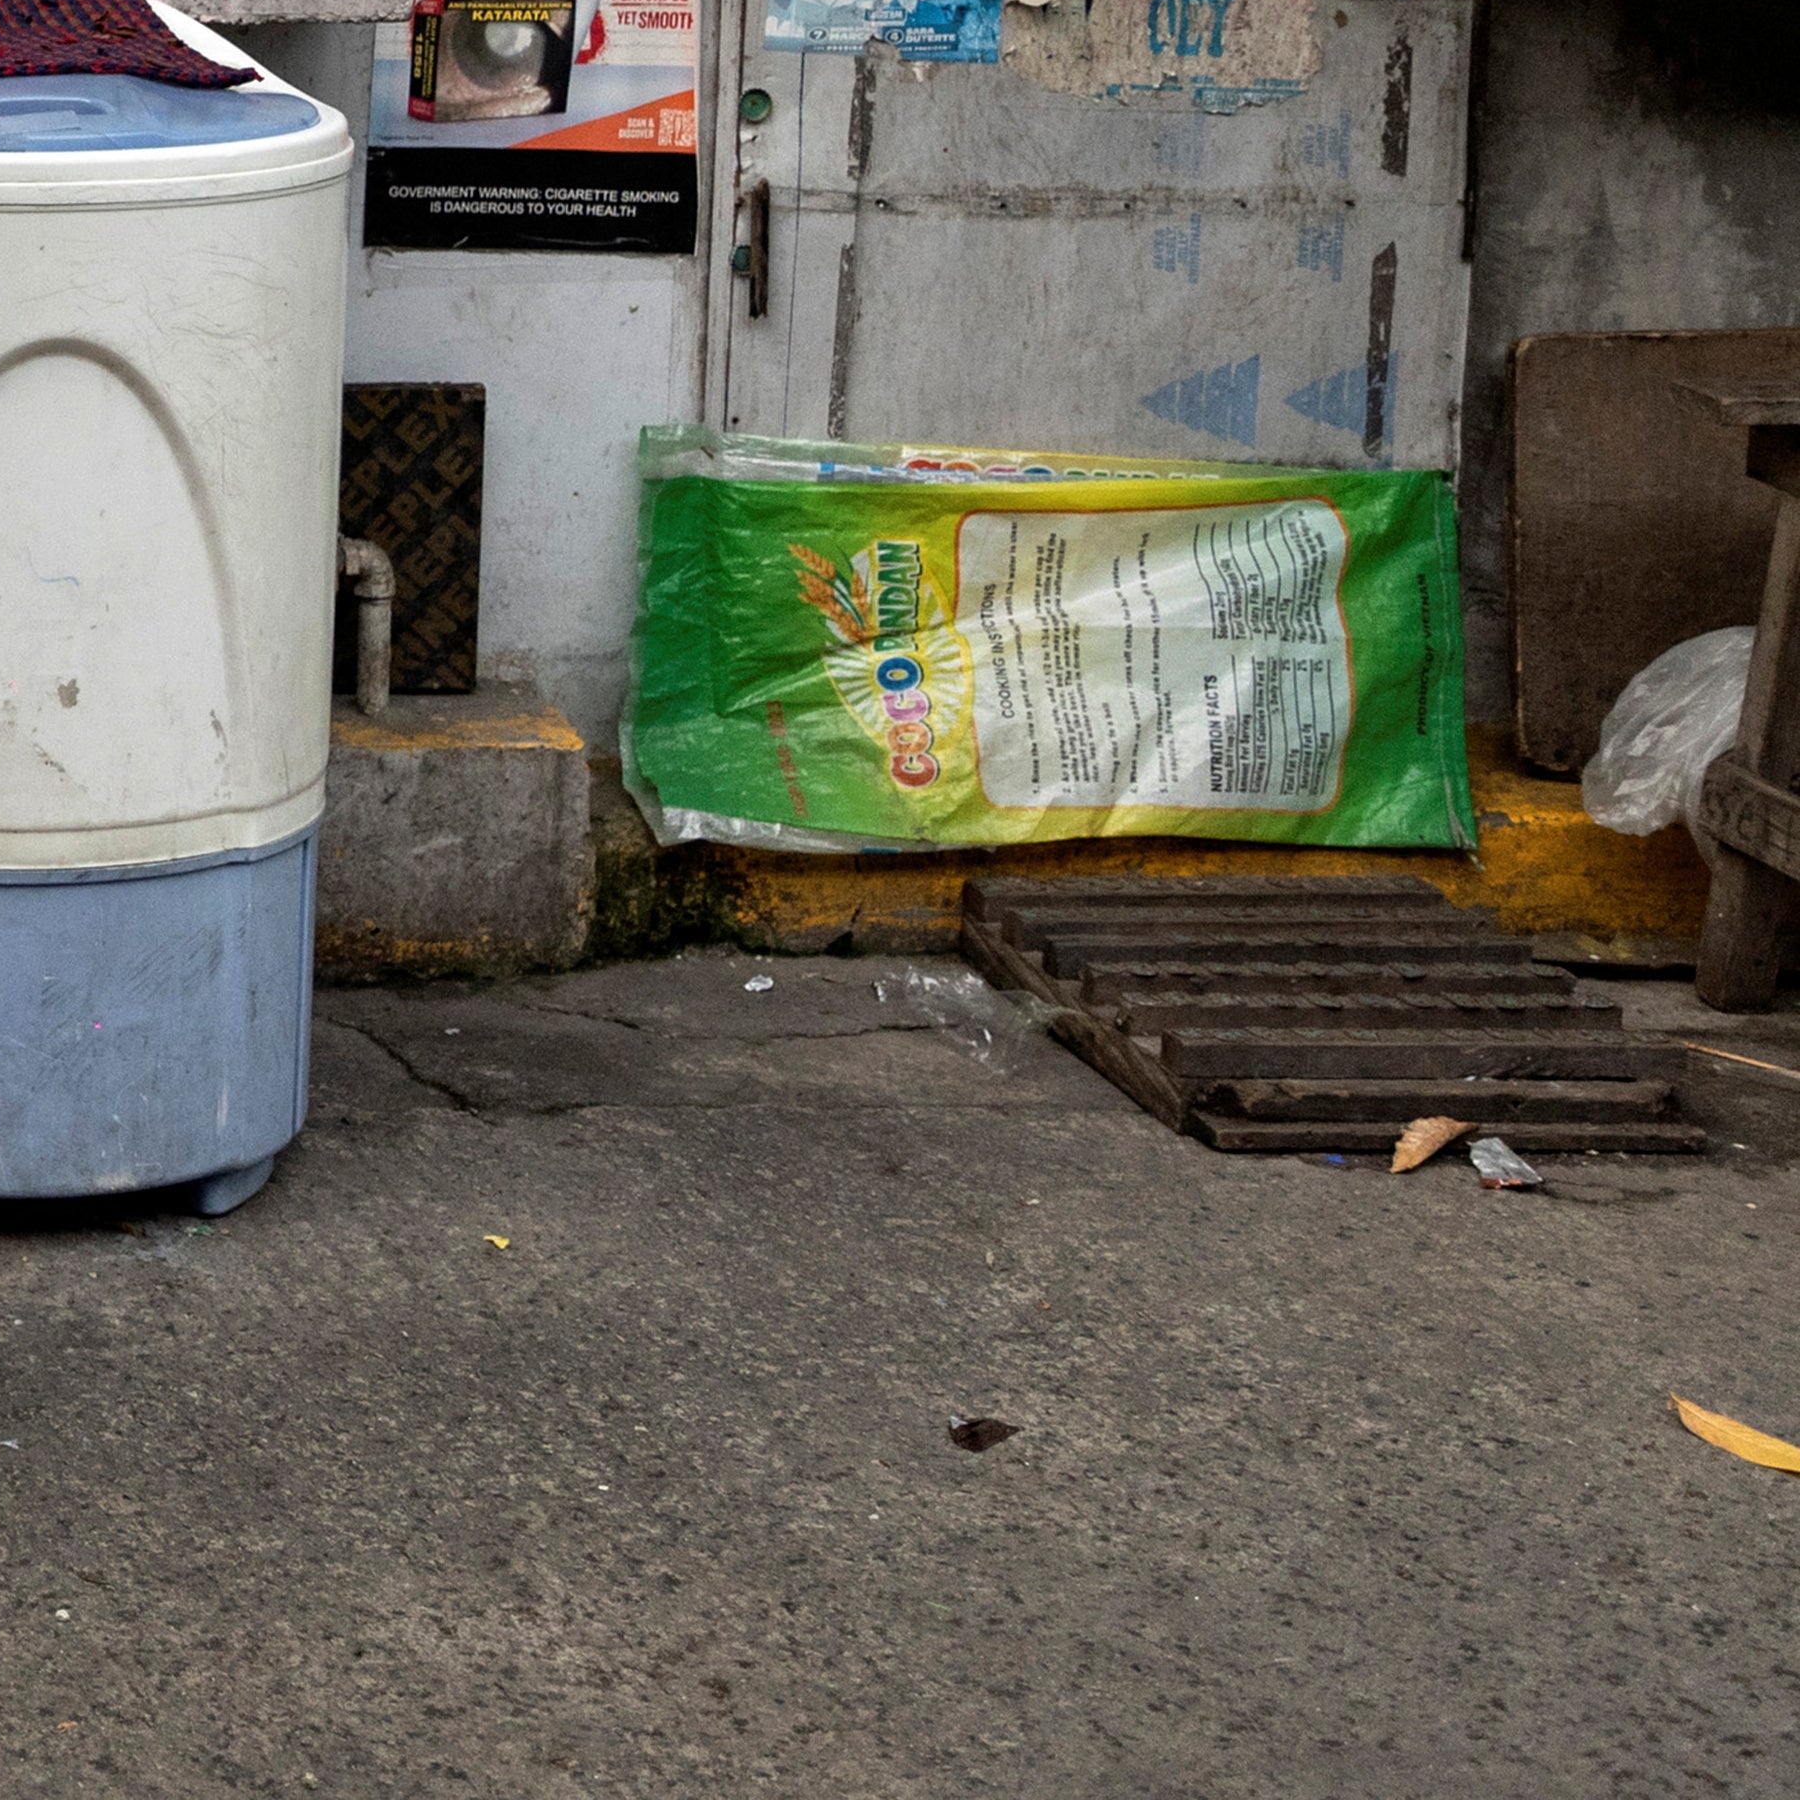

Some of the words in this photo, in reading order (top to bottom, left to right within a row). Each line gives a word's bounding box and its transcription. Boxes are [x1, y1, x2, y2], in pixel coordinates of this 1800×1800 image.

[472, 9, 550, 21] KATARATA
[617, 11, 636, 25] YET
[905, 27, 935, 35] SARA
[905, 34, 956, 42] DUTERTE
[389, 186, 476, 200] GOVERNMENT
[478, 187, 543, 201] WARNING:
[544, 188, 619, 203] CIGARETTE
[621, 190, 680, 204] SMOKING
[430, 202, 442, 214] IS
[444, 202, 524, 215] DANGEROUS
[528, 203, 544, 215] TO
[546, 204, 584, 216] YOUR
[586, 204, 637, 218] HEALTH
[1049, 533, 1057, 546] the
[1035, 557, 1044, 571] cup
[1046, 548, 1055, 563] find
[1250, 584, 1259, 603] Fiber
[1416, 573, 1431, 639] VIETNAM
[1217, 610, 1228, 639] Sodium
[1234, 620, 1247, 640] Total
[1052, 635, 1062, 652] may
[1124, 624, 1132, 649] check
[1152, 627, 1160, 659] another
[1055, 655, 1064, 670] you
[1062, 646, 1071, 667] more
[1124, 650, 1132, 663] off
[1425, 646, 1433, 663] OF
[1020, 679, 1028, 692] rid
[1055, 673, 1063, 688] but
[1064, 670, 1073, 686] The
[1153, 677, 1161, 695] rice
[992, 657, 1015, 719] COOKING
[1204, 675, 1220, 716] FACTS
[1256, 688, 1264, 707] from
[1270, 685, 1279, 705] Daily
[1023, 694, 1033, 708] get
[1128, 691, 1141, 721] cooker
[1417, 666, 1430, 735] PRODUCT
[874, 655, 941, 790] COCO
[1155, 697, 1163, 732] covered
[1083, 714, 1094, 738] water
[1241, 714, 1251, 744] Serving
[1257, 710, 1266, 743] Calories
[1055, 727, 1068, 760] general
[1076, 732, 1087, 746] you
[1302, 736, 1312, 749] Fat
[1209, 720, 1222, 793] NUTRITION
[1241, 747, 1249, 760] Per
[1032, 760, 1040, 784] Rinse
[1070, 757, 1079, 781] white
[1286, 761, 1296, 773] Fat
[1300, 751, 1311, 789] Saturated
[1240, 762, 1250, 793] Amount
[1252, 762, 1266, 793] Calories
[1284, 776, 1294, 795] Total
